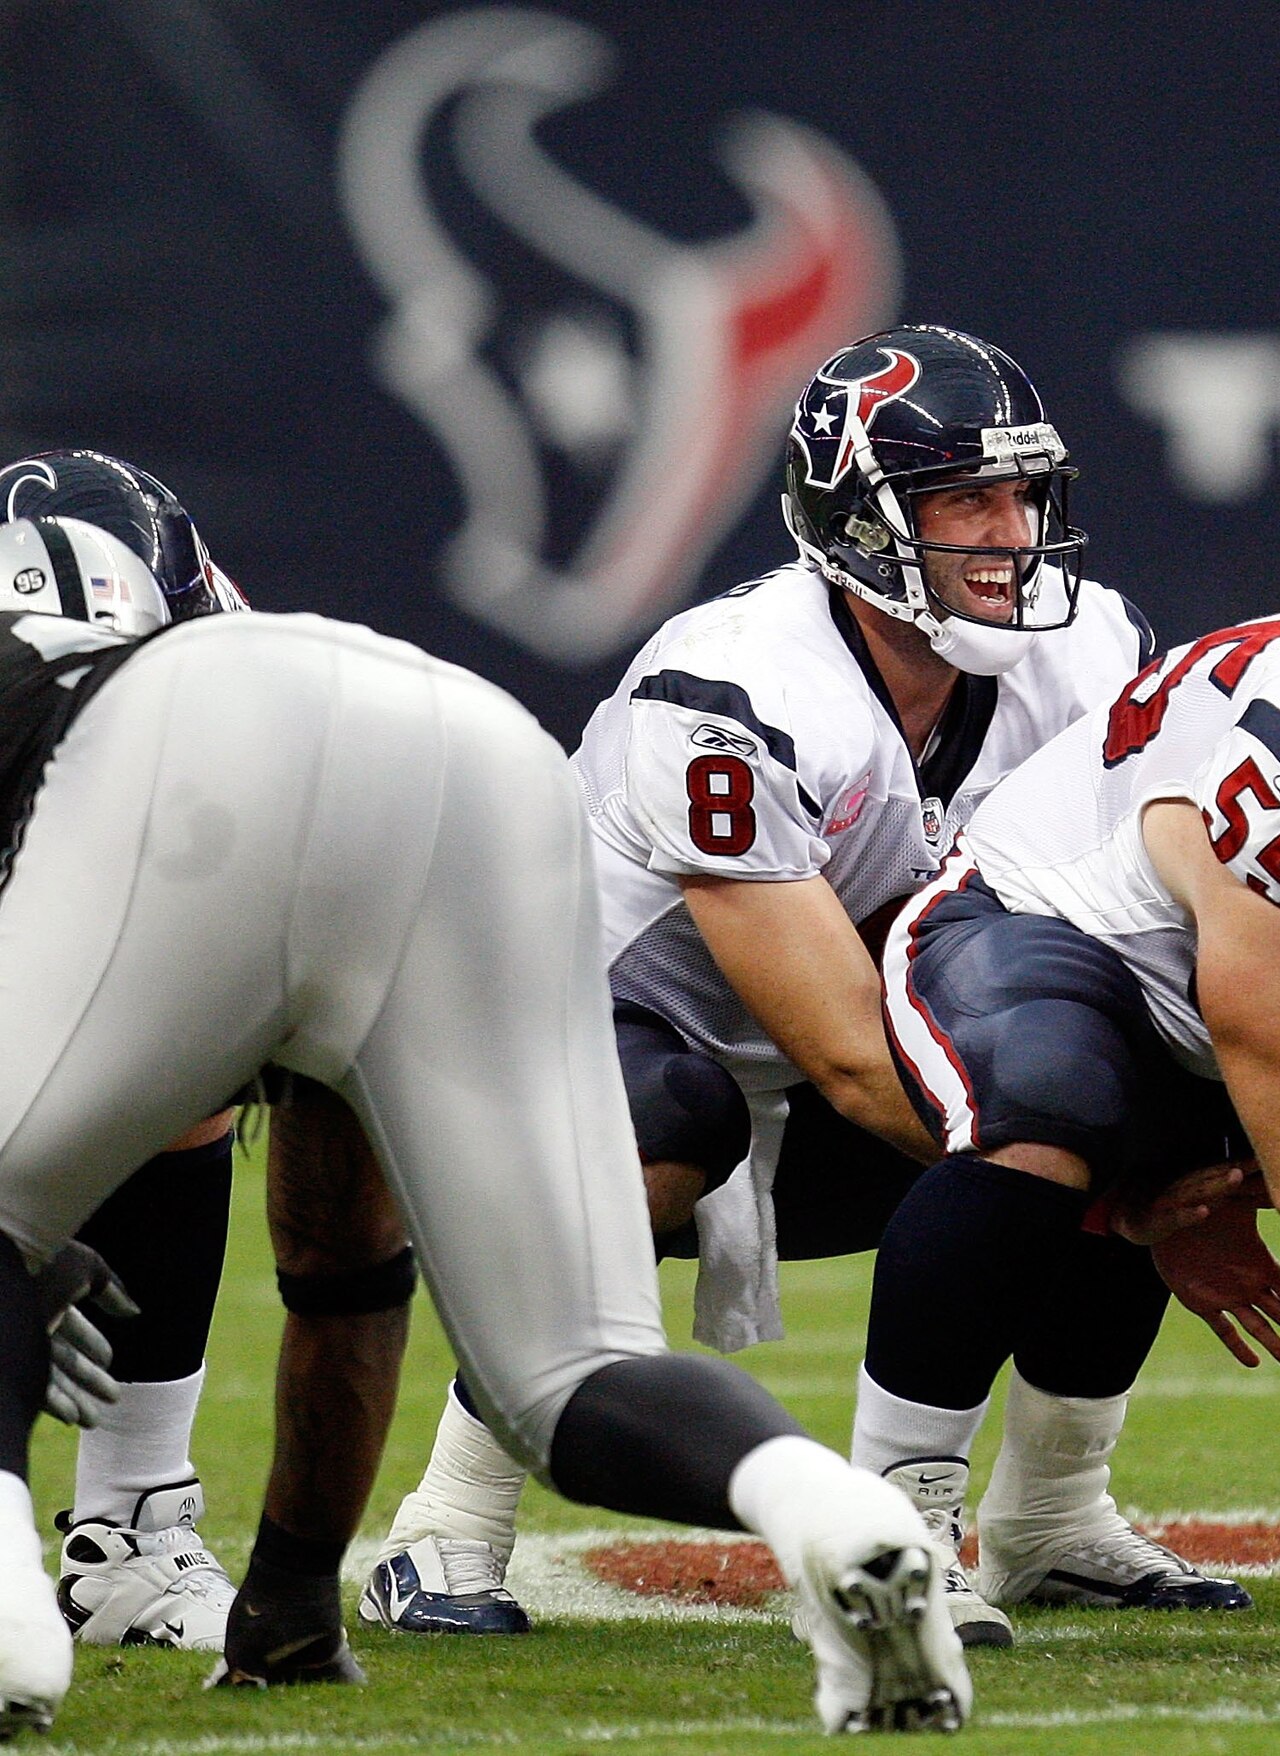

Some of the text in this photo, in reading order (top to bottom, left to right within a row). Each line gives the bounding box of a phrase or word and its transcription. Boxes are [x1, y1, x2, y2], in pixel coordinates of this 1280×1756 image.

[15, 570, 44, 593] 95
[686, 754, 757, 857] 8
[173, 1552, 210, 1571] NIKE
